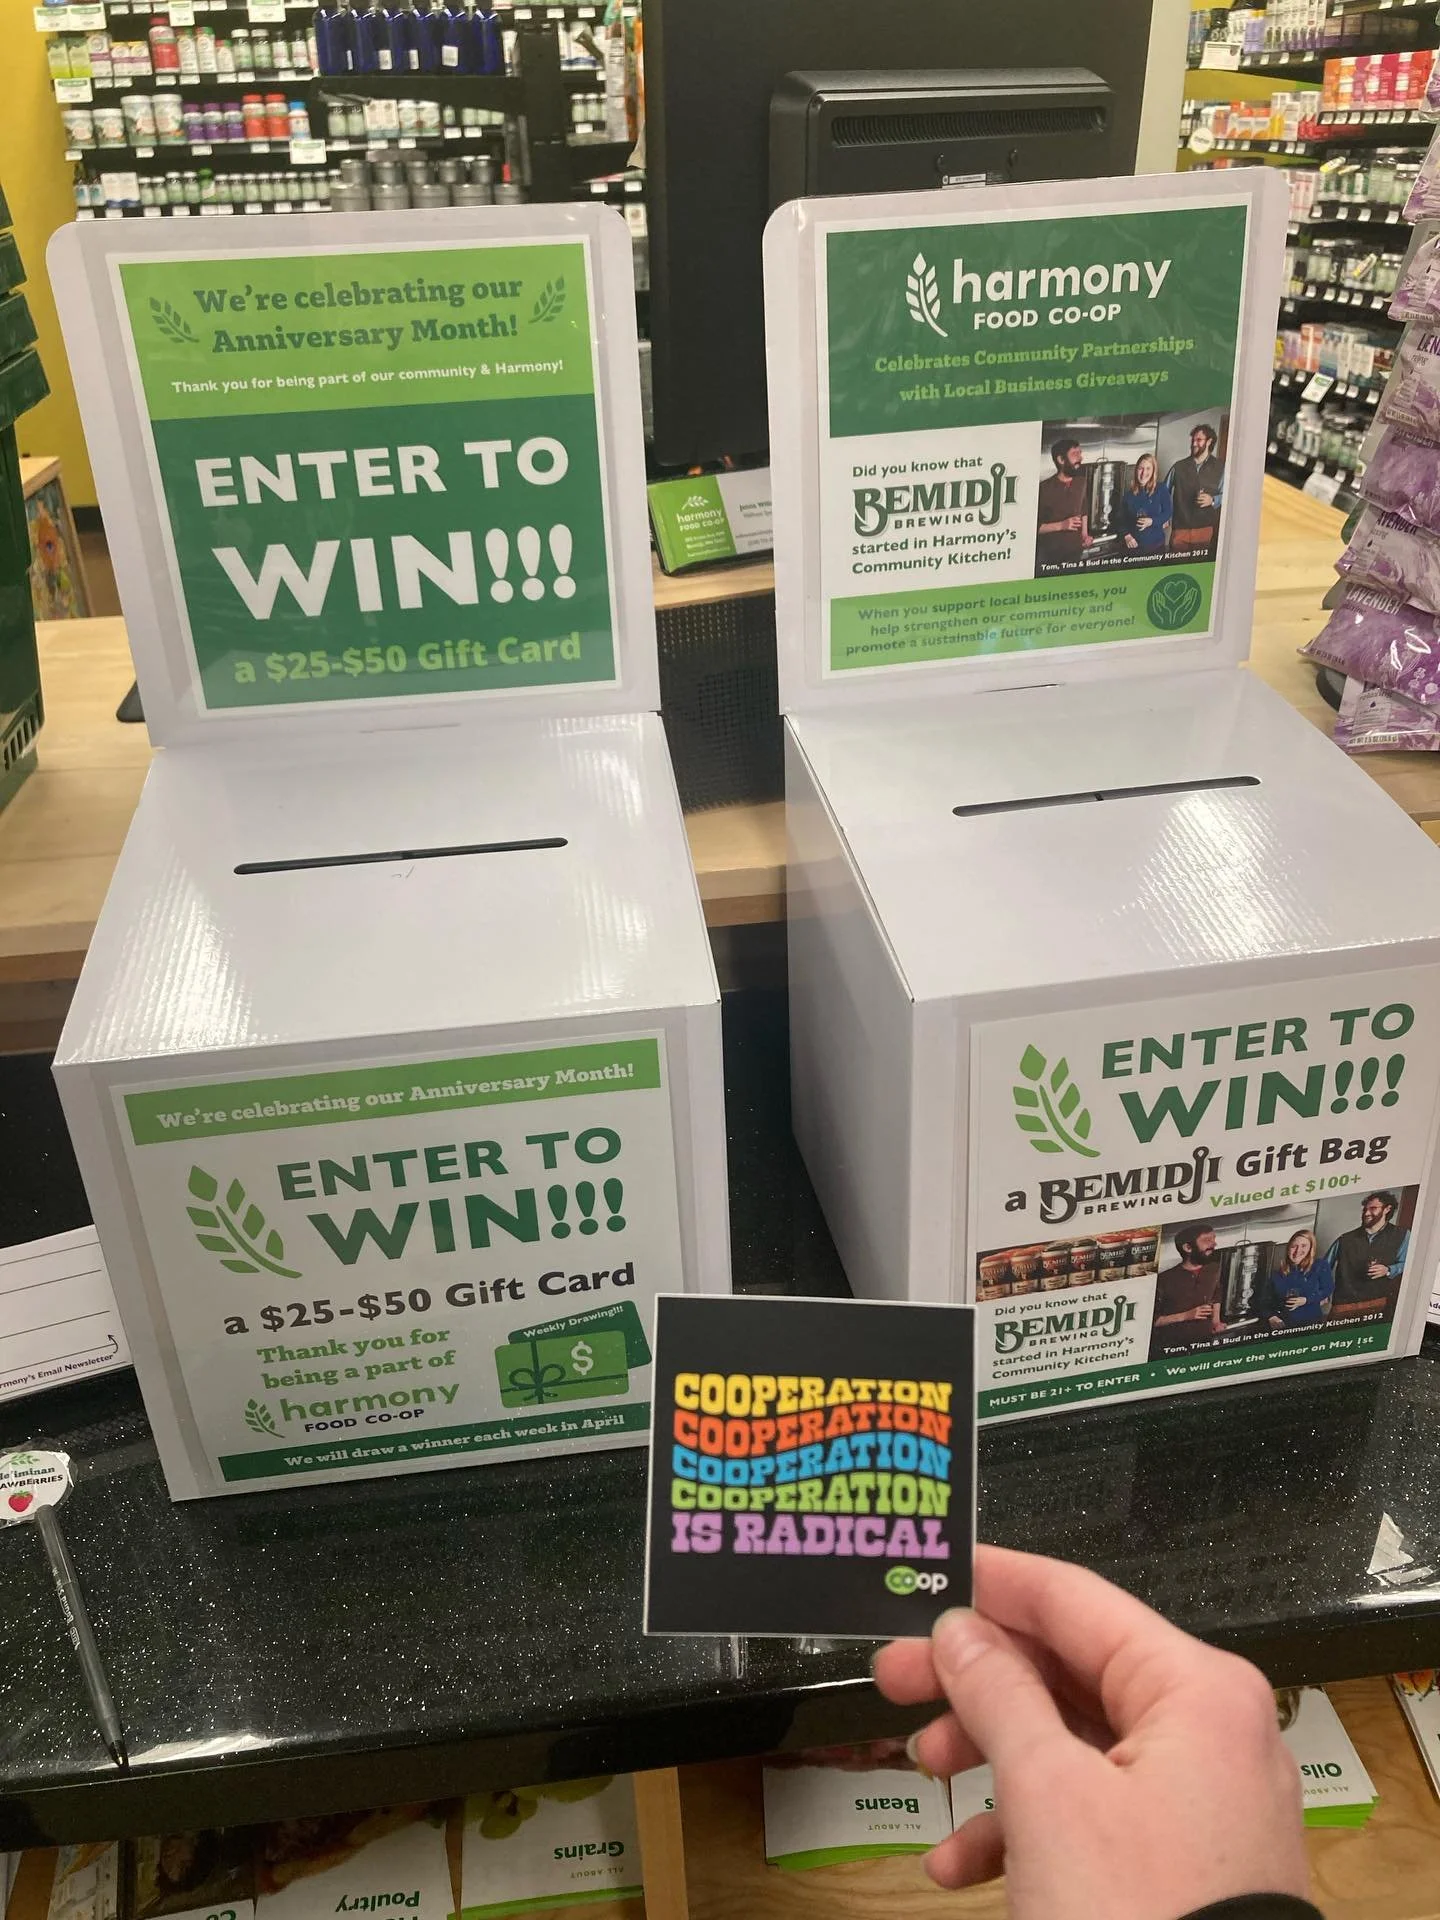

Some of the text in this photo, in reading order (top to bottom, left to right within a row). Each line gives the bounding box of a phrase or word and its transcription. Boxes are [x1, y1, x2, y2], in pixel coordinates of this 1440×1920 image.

[194, 278, 523, 313] We're celebrating our
[953, 258, 1172, 304] harmony
[212, 314, 517, 353] Anniversary Month!
[973, 303, 1122, 330] FOOD CO-OP
[875, 336, 1194, 373] Celebrates Community Partnerships
[172, 359, 564, 393] Thank you for being part of our community Harmony!
[900, 368, 1169, 401] with Local Business Giveaways
[195, 436, 569, 508] ENTER TO
[853, 456, 983, 478] Did you know that
[853, 462, 1017, 537] BEMIDJI
[894, 512, 974, 529] BREWING
[852, 529, 1017, 555] started in Harmony's
[1062, 551, 1191, 569] Tina Community Kitchen
[211, 524, 576, 620] WIN!!!
[852, 548, 1011, 575] Community Kitchen!
[858, 585, 1127, 621] When you support local businesses, you
[870, 602, 1113, 638] help strengthen our community and
[846, 615, 1135, 656] promote sustainable future for everyone!
[235, 631, 582, 685] a $25-$50 Gift Card
[1102, 1003, 1415, 1079] ENTER TO
[157, 1062, 635, 1129] We're celebrating our Anniversary Month!
[1119, 1053, 1406, 1144] WIN!!!
[277, 1127, 622, 1201] ENTER TO
[1004, 1135, 1391, 1224] a BEMIDJI Gift Bag
[1084, 1194, 1172, 1215] BREWING
[1210, 1173, 1361, 1208] Valued at $100+
[307, 1177, 627, 1266] WIN!!!
[224, 1262, 636, 1335] a $25-$50 Gift Card
[994, 1292, 1108, 1316] Did you know that
[523, 1305, 625, 1339] Weekly Drawing!!!
[994, 1295, 1136, 1354] BEMIDJI
[1029, 1329, 1100, 1346] BREWING
[1190, 1312, 1384, 1350] Tina Community Kitchen 2012
[257, 1327, 451, 1364] Thank you for
[570, 1342, 594, 1376] $
[992, 1336, 1134, 1367] started in Harmony's
[992, 1349, 1129, 1379] Community Kitchen!
[1166, 1338, 1353, 1376] We will draw the winner on May
[38, 1367, 62, 1379] Email
[65, 1354, 114, 1372] Newsletter
[262, 1350, 456, 1390] being a part of
[280, 1383, 460, 1422] harmony
[674, 1373, 952, 1417] COOPERATION
[989, 1374, 1141, 1408] MUST BE 21+ TO ENTER
[304, 1408, 425, 1433] FOOD CO-OP
[673, 1401, 952, 1457] COOPERATION
[284, 1414, 625, 1469] We will draw winner each week in April
[672, 1432, 952, 1486] COOPERATION
[671, 1471, 951, 1517] COOPERATION
[671, 1512, 949, 1560] IS RADICAL
[1300, 1762, 1342, 1779] Oils
[855, 1798, 920, 1814] Beans
[554, 1841, 624, 1861] Grains
[335, 1890, 420, 1912] Poultry
